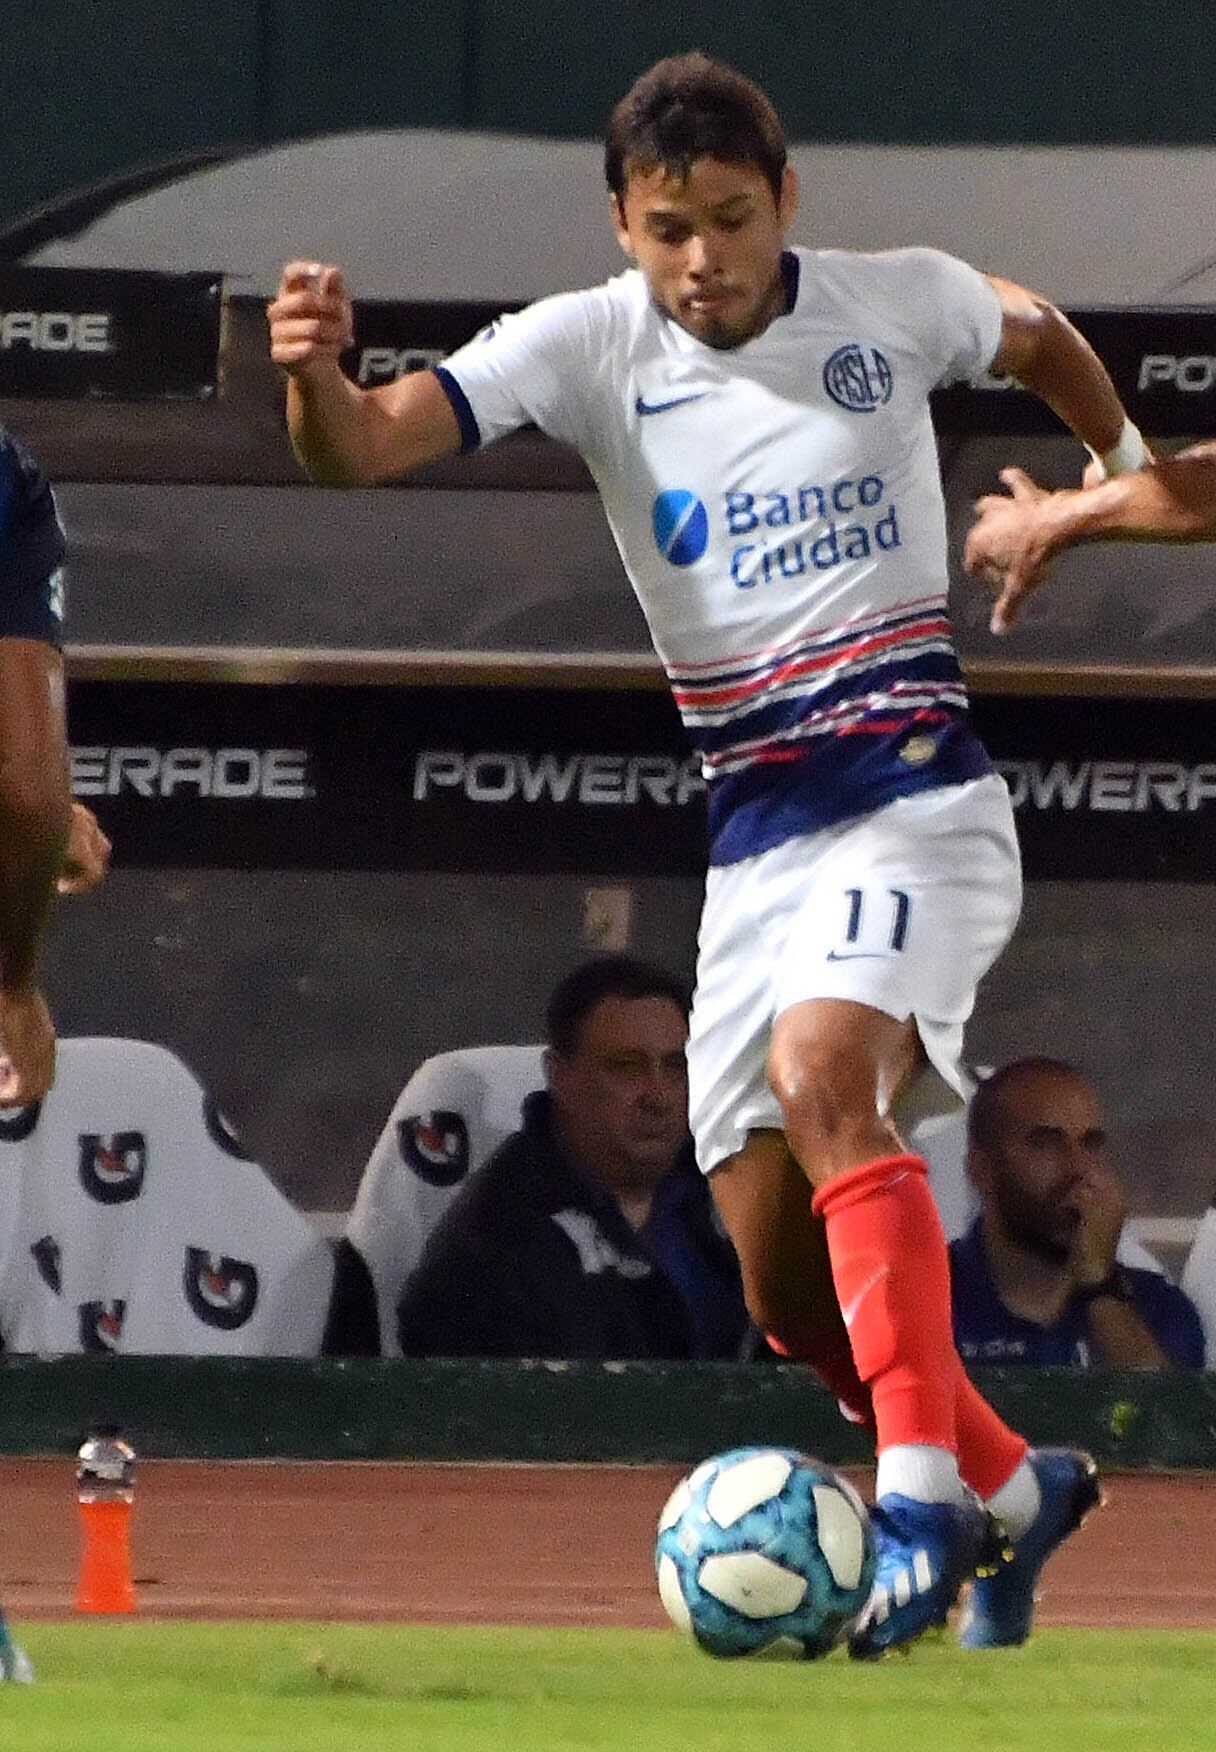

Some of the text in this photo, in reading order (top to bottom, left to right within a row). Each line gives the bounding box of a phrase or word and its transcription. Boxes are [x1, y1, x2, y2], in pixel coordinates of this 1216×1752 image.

[727, 475, 883, 535] Banco
[730, 505, 902, 588] Ciudad
[845, 889, 909, 951] 11
